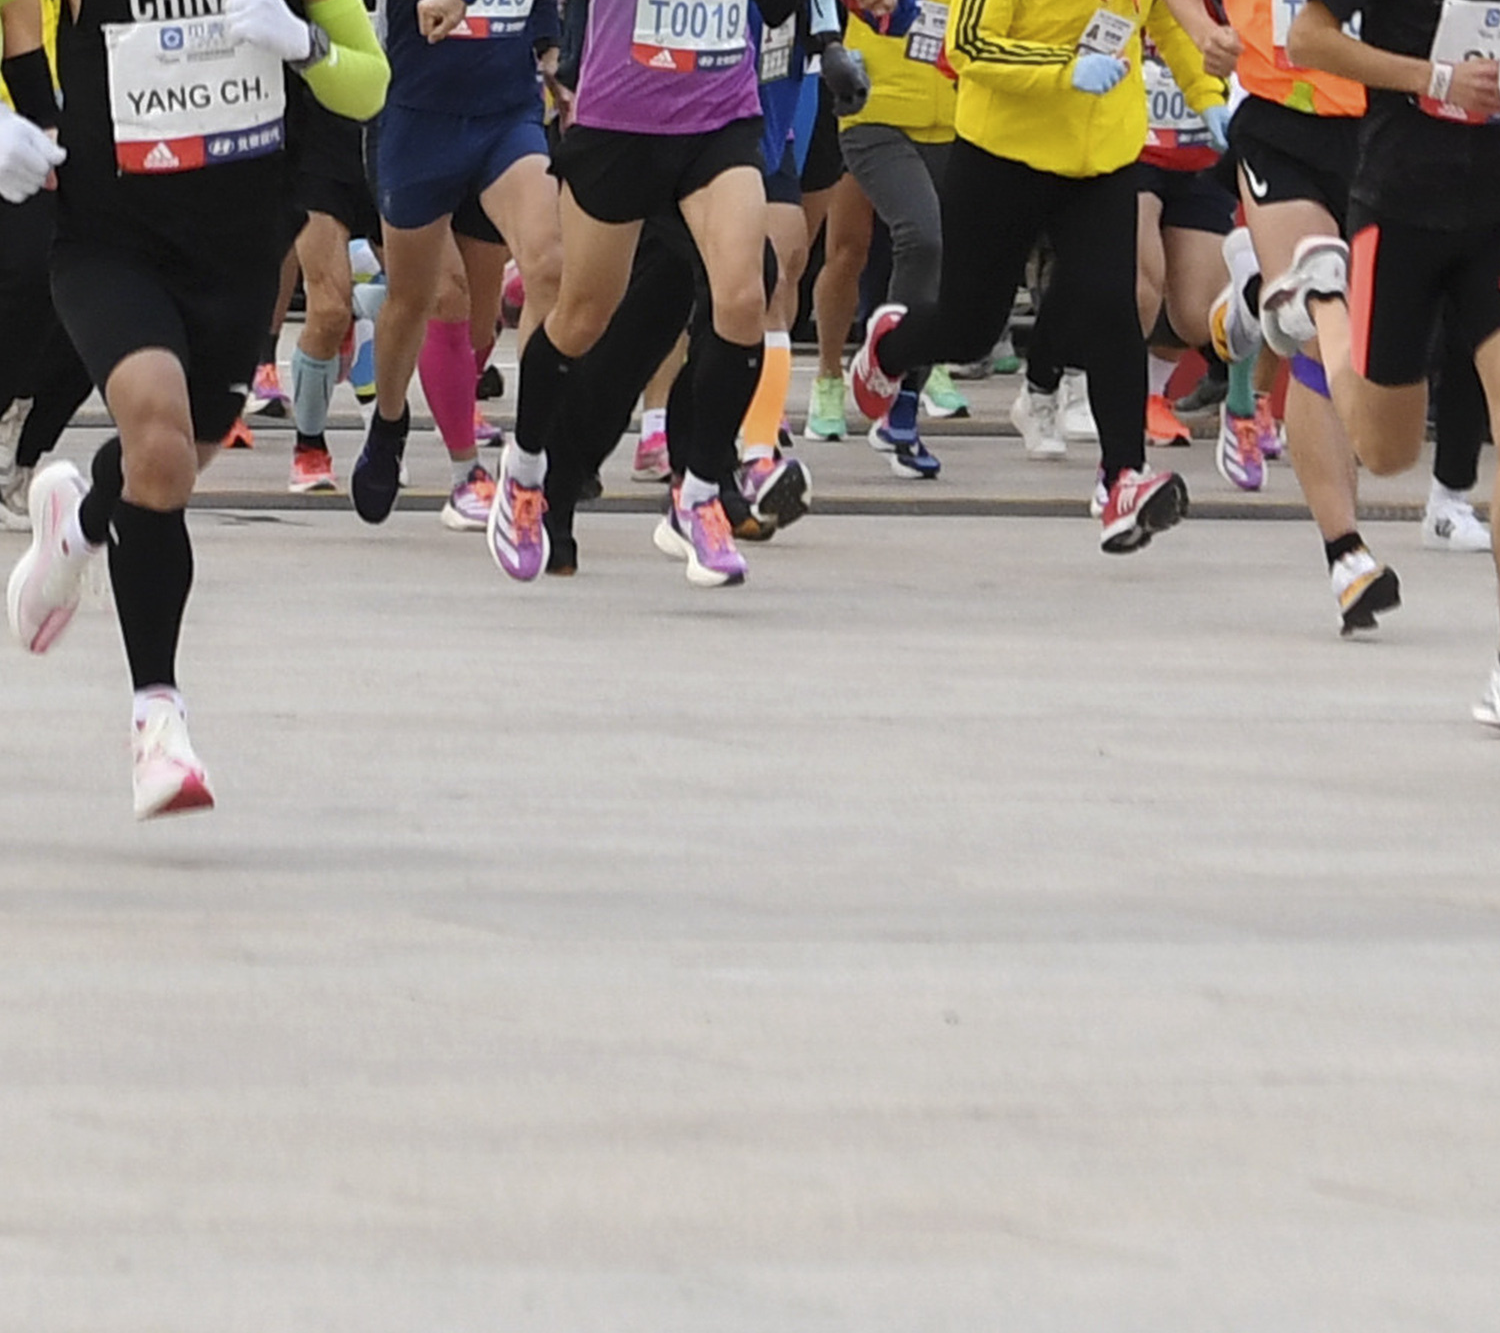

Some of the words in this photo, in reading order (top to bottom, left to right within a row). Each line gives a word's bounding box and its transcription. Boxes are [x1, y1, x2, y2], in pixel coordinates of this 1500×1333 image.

[648, 0, 741, 41] T0019
[127, 84, 212, 117] YANG
[219, 75, 270, 106] CH.
[1145, 89, 1198, 121] 00
